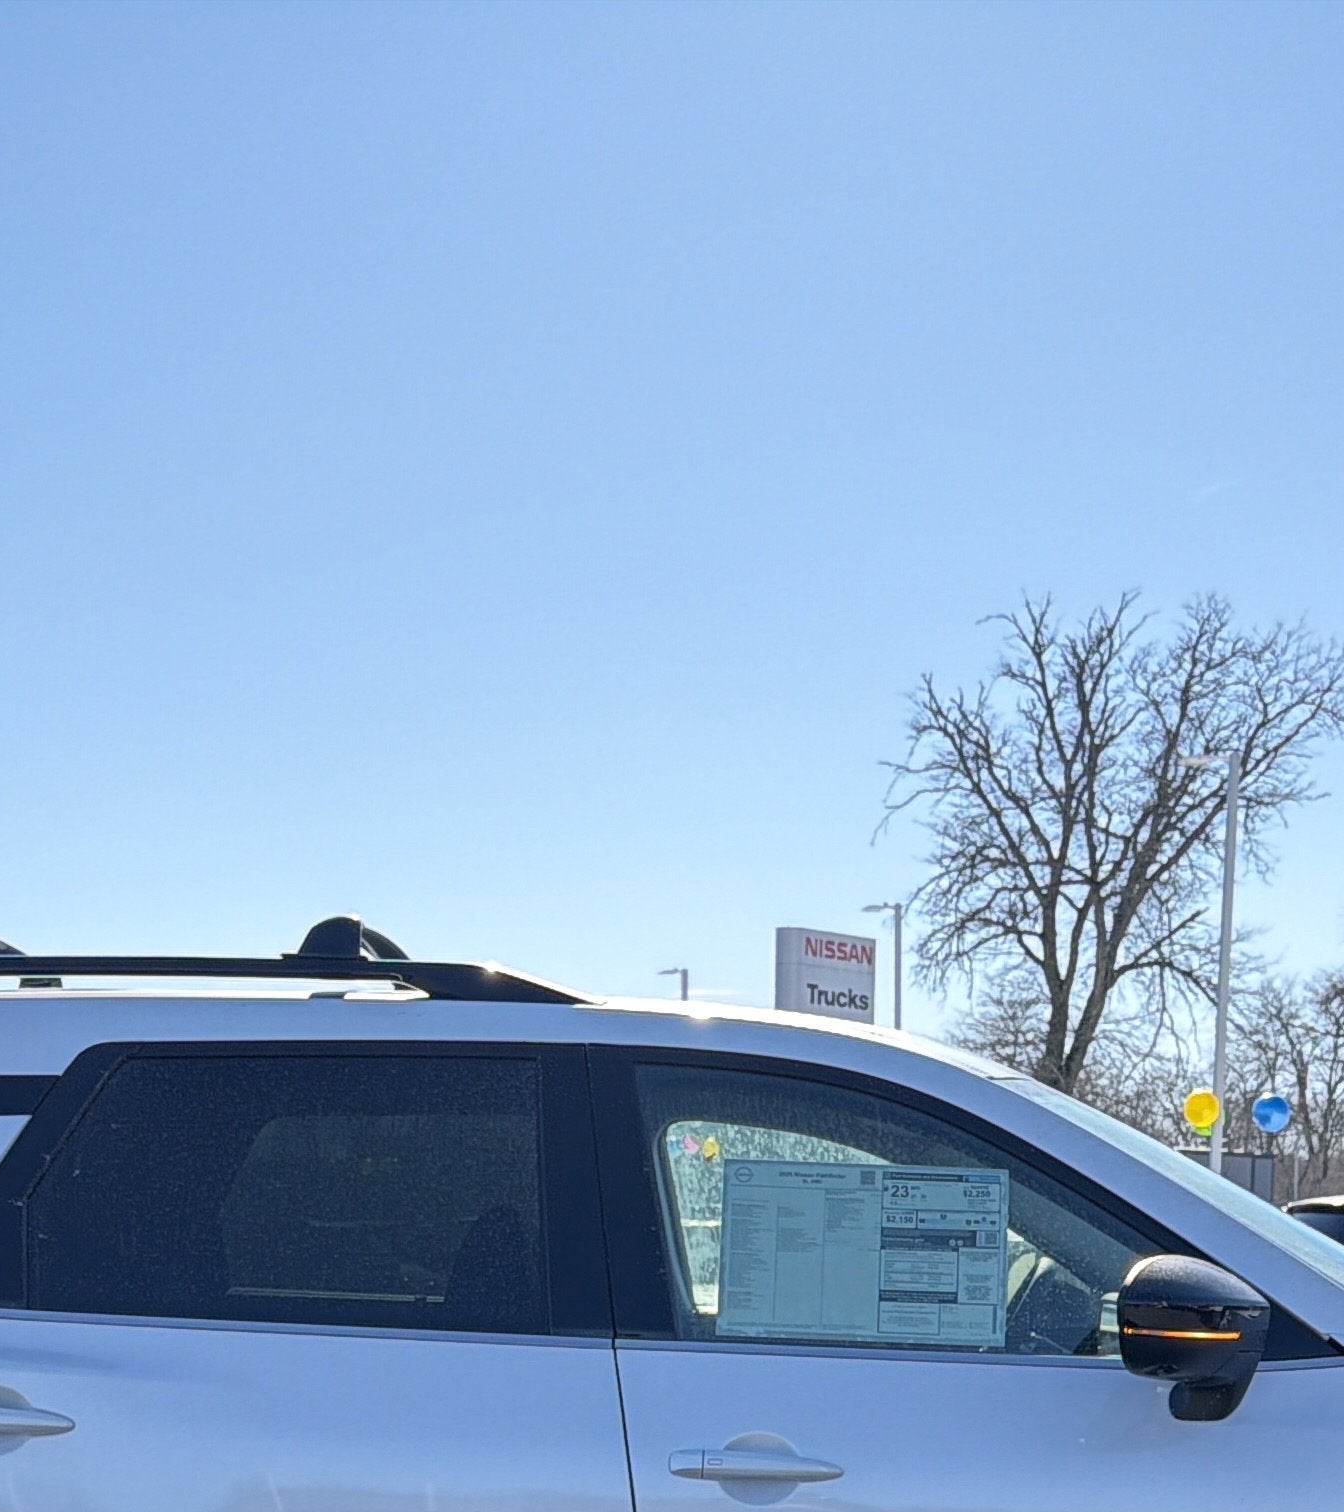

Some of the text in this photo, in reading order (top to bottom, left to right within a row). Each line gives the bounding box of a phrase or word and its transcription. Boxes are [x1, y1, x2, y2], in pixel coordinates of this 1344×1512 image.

[804, 936, 873, 966] NISSAN
[806, 982, 869, 1011] Trucks
[891, 1184, 909, 1198] 23
